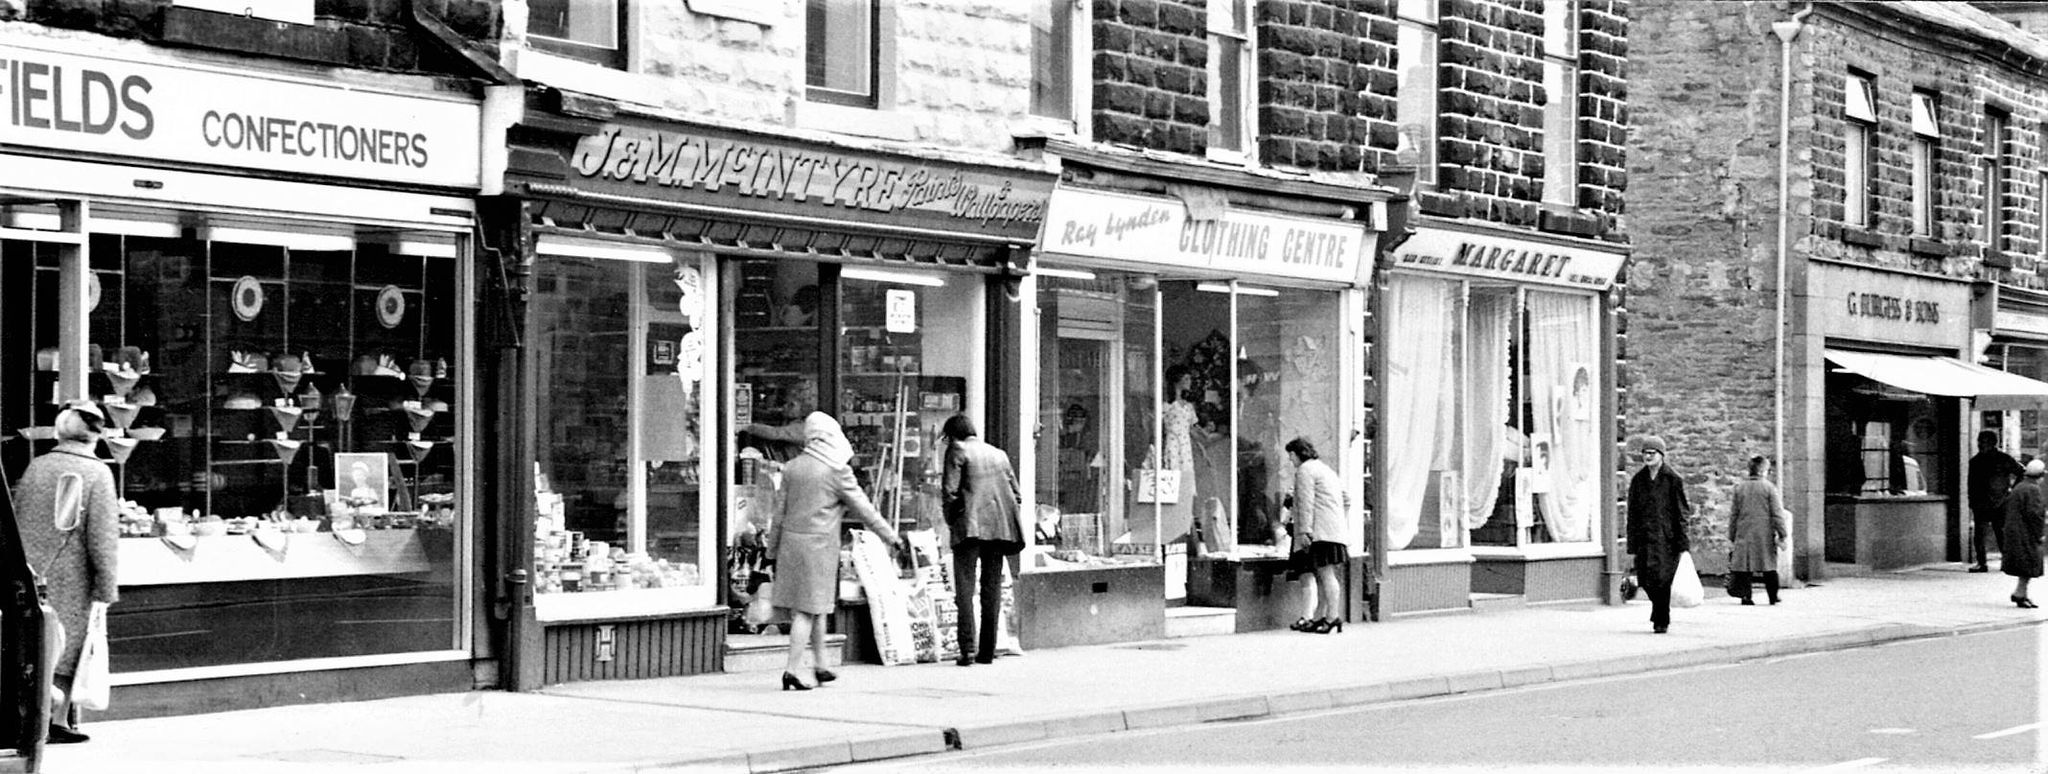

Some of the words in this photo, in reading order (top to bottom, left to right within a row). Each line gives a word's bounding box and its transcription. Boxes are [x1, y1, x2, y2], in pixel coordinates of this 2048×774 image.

[202, 110, 428, 168] CONFECTIONERS
[1061, 220, 1097, 248] Ray
[1104, 206, 1171, 242] Lynden
[1179, 219, 1270, 260] CLOTHING
[1282, 228, 1348, 269] CENTRE
[1453, 242, 1571, 278] MARGARET
